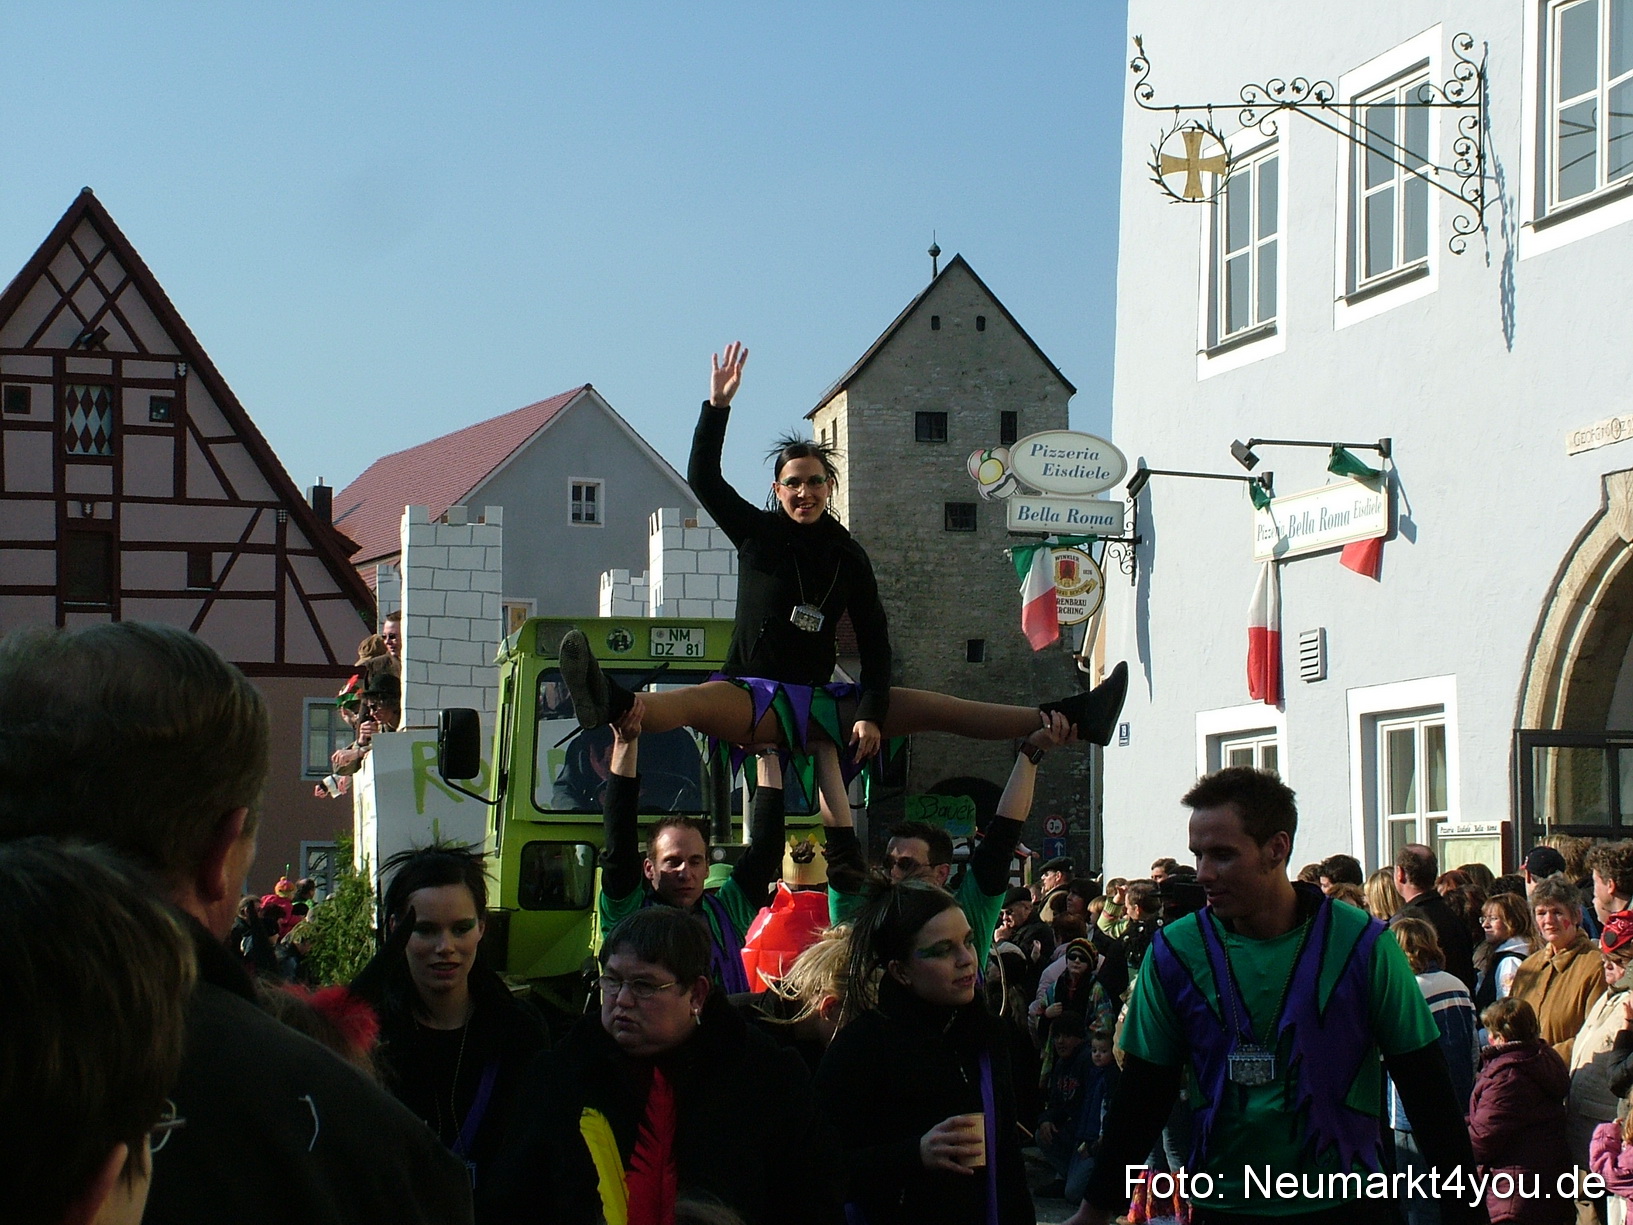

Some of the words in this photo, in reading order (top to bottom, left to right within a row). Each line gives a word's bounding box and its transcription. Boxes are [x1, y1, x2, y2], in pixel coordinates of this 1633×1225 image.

[1030, 443, 1100, 461] Pizzeria
[1042, 462, 1110, 480] Eisdiele
[1018, 505, 1060, 522] Bella
[1066, 508, 1114, 526] Roma
[1288, 511, 1315, 539] Bella
[1319, 506, 1350, 532] Roma
[1353, 495, 1382, 519] Eisdiele
[1057, 606, 1084, 615] RCHING
[669, 629, 691, 641] NM
[655, 643, 674, 656] DZ
[686, 643, 699, 656] 81
[918, 795, 975, 820] Bauer
